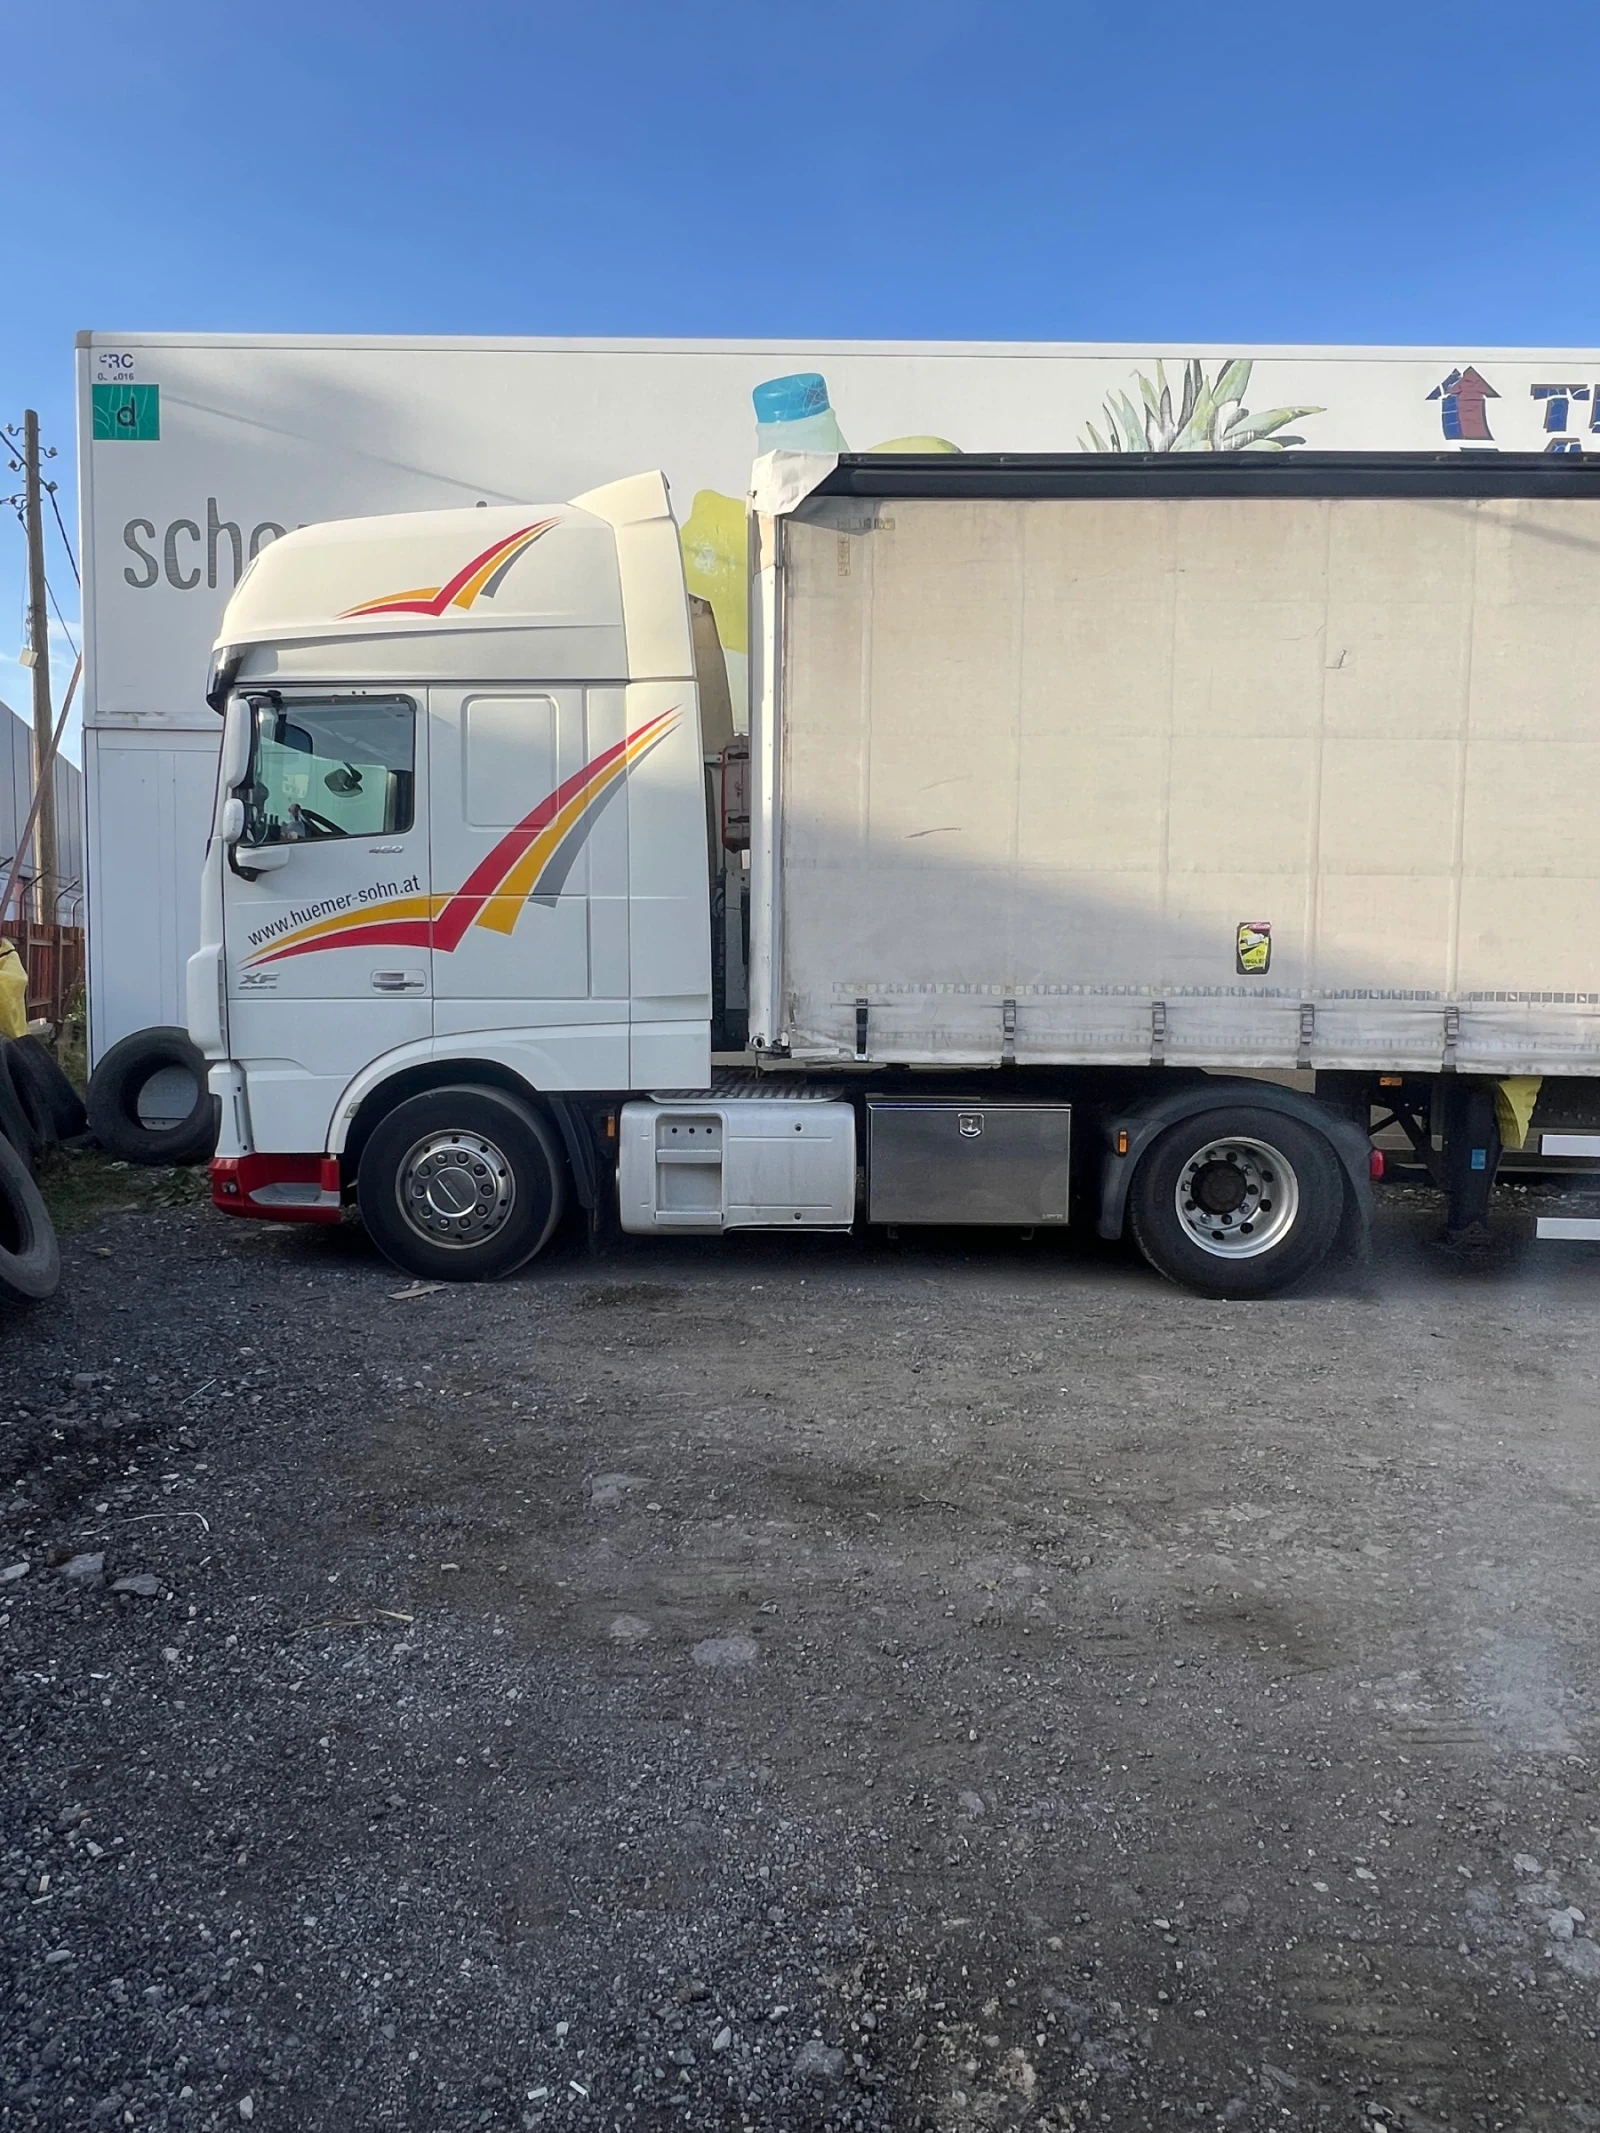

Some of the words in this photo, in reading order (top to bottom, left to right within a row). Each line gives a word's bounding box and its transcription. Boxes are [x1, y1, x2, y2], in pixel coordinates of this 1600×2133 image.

[1530, 384, 1600, 433] T
[248, 874, 421, 946] www.huemer-sohn.at
[240, 972, 281, 985] XF
